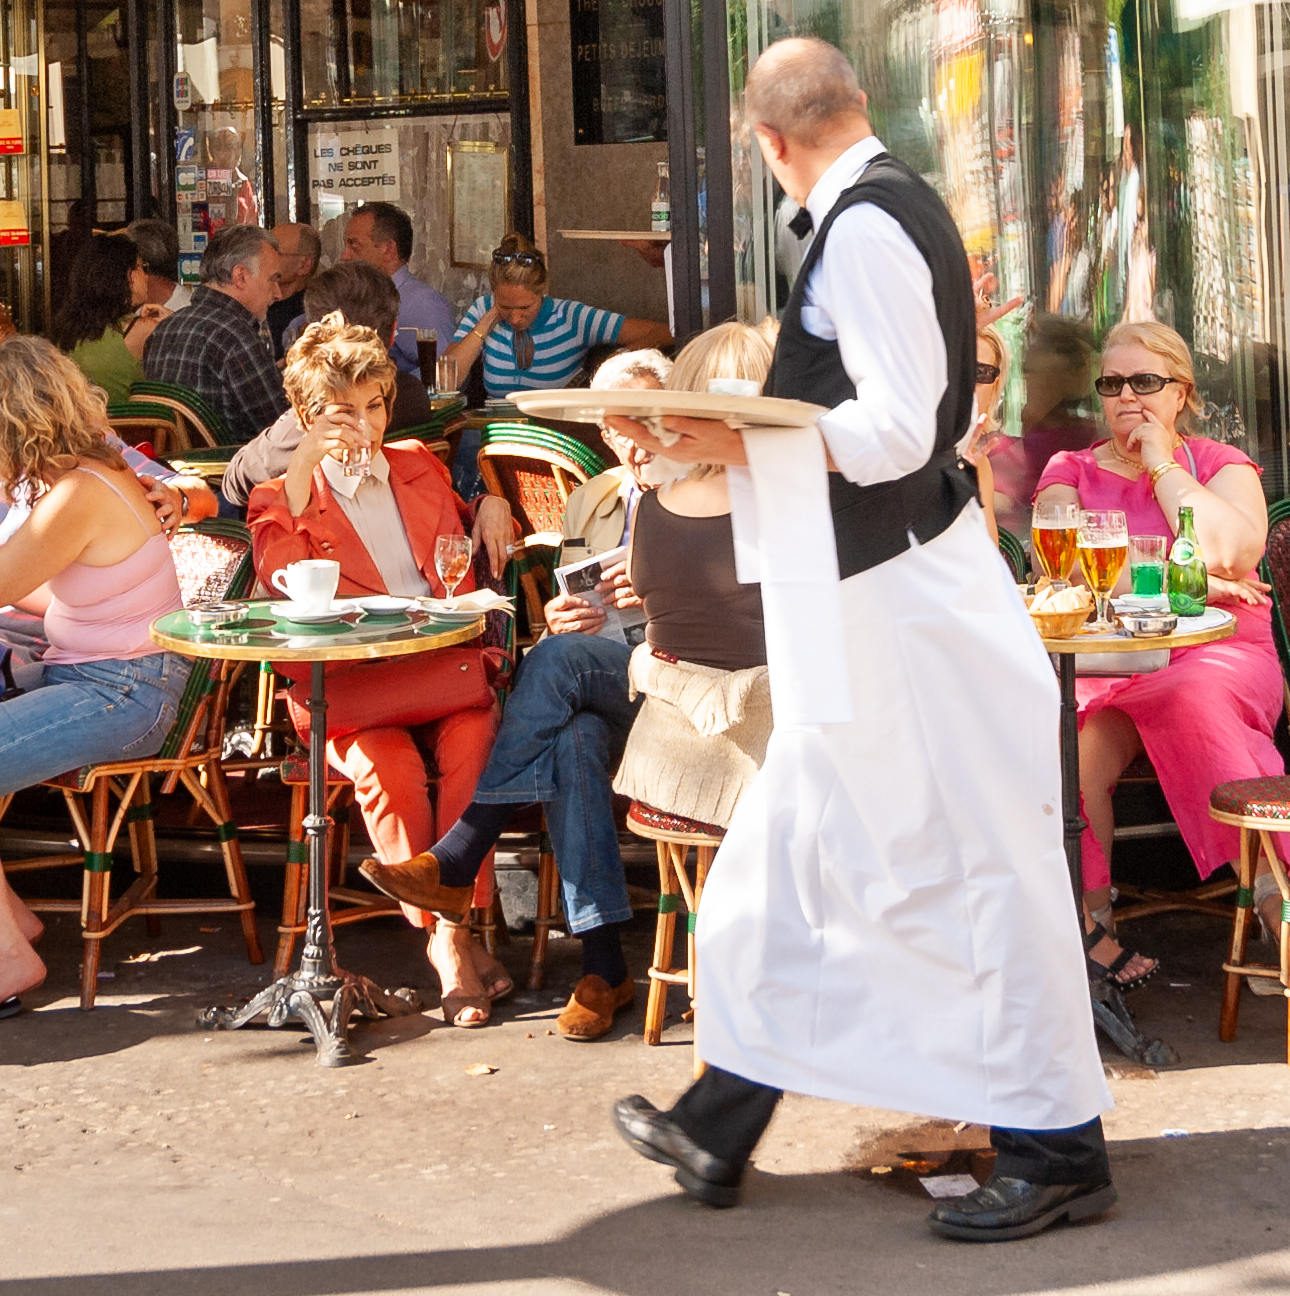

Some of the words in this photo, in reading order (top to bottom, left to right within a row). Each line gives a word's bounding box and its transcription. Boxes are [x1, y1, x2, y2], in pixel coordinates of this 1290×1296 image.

[314, 148, 334, 158] LES
[328, 162, 343, 172] NE
[348, 160, 378, 171] SONT
[312, 179, 333, 189] PAS
